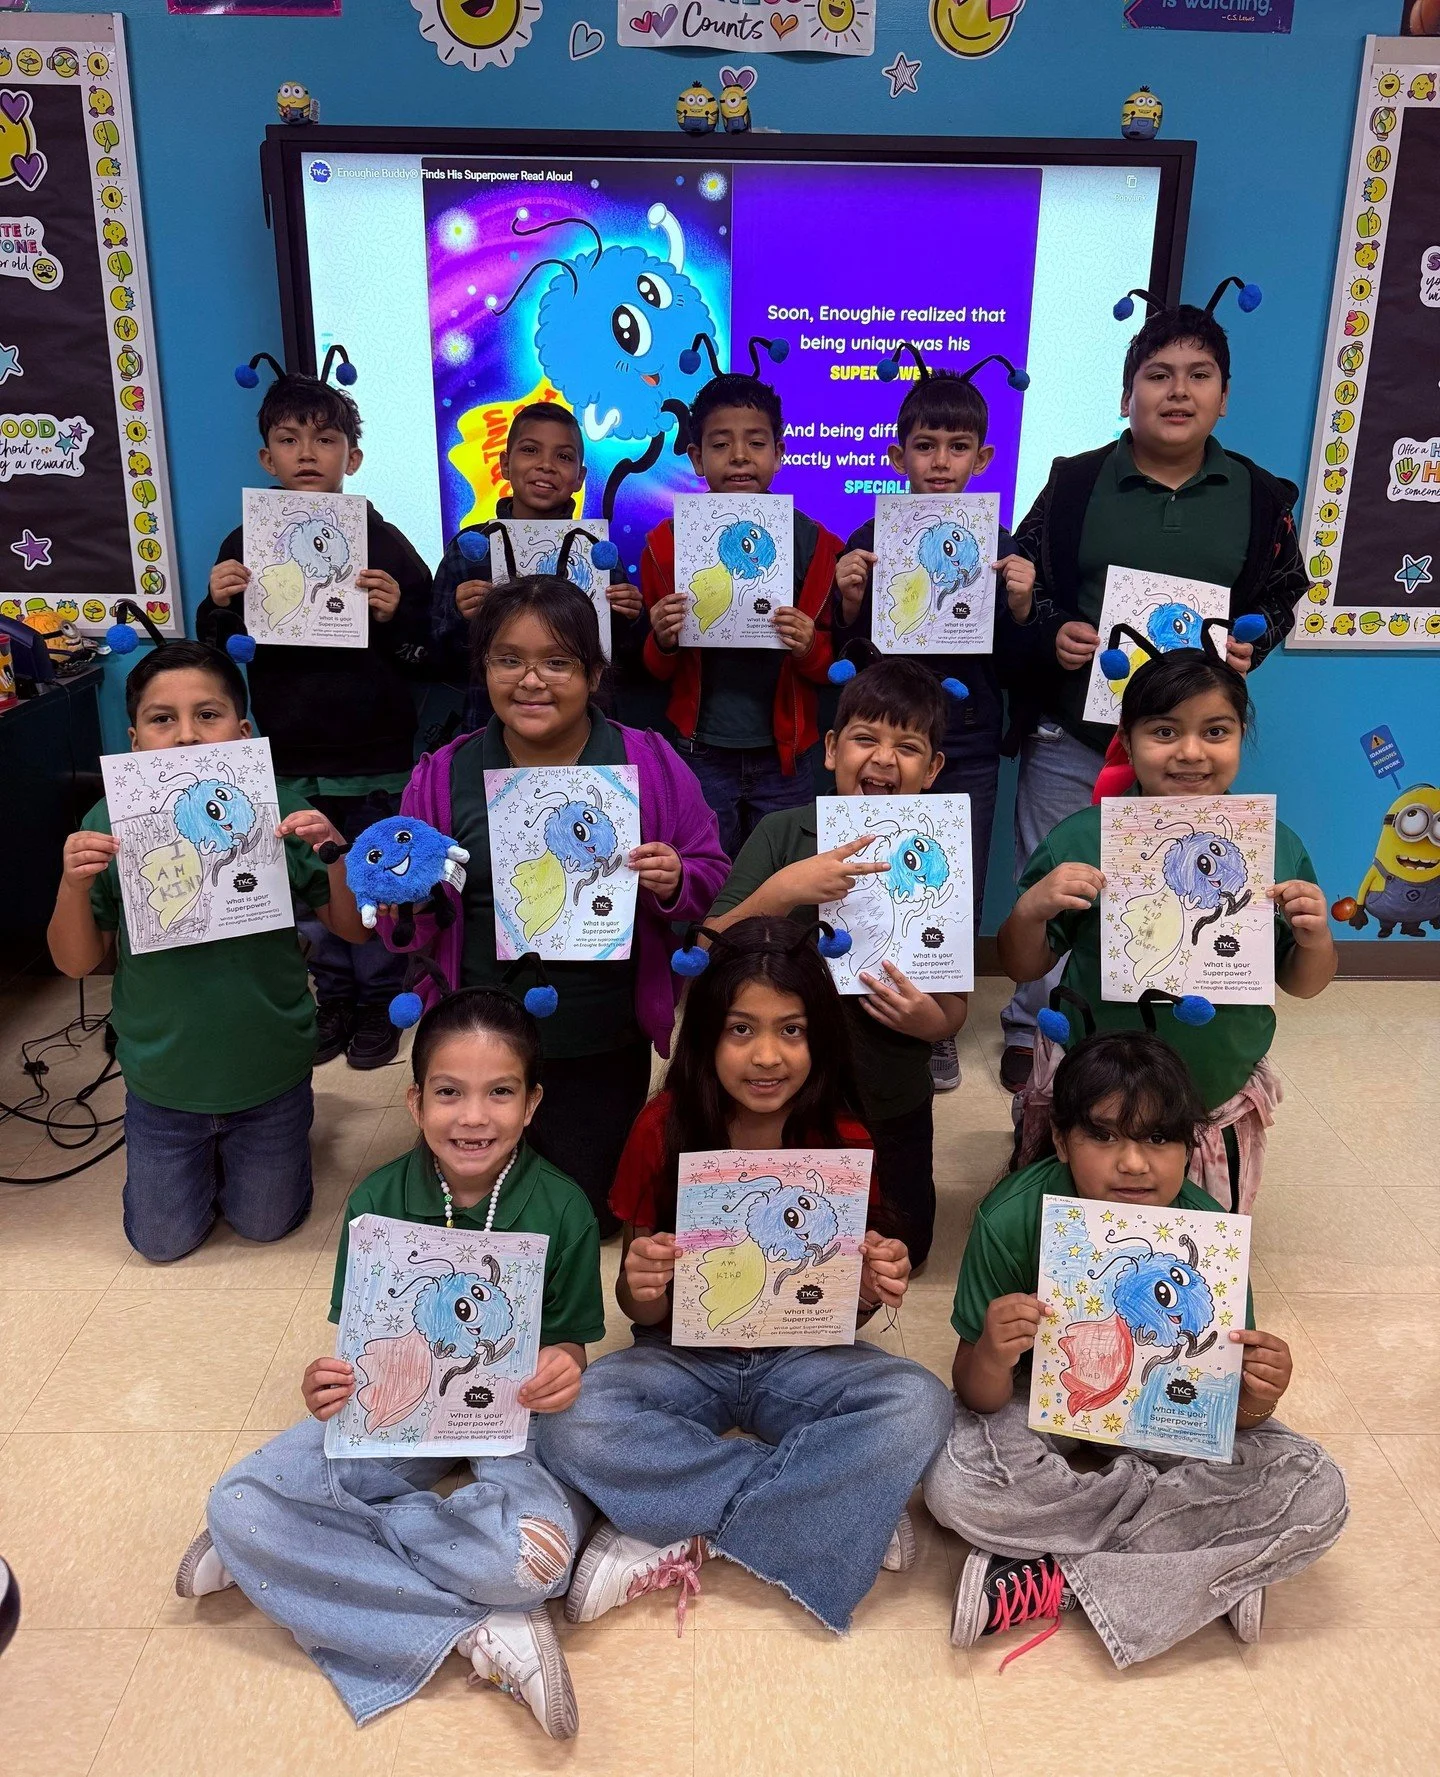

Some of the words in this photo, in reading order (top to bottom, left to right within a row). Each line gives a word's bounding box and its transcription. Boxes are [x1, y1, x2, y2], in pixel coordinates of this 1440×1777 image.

[682, 1, 765, 41] Counts
[312, 168, 328, 177] TKC
[337, 167, 380, 179] Enoughie
[420, 168, 446, 180] Finds
[447, 169, 463, 180] His
[464, 170, 519, 182] Superpower
[520, 171, 544, 181] Read
[545, 171, 573, 182] Aloud
[767, 305, 814, 323] Soon,
[819, 305, 896, 325] Enoughie
[900, 306, 966, 322] realized
[970, 307, 1006, 323] that
[800, 334, 846, 353] being
[851, 336, 905, 353] unique
[910, 338, 943, 351] was
[948, 335, 971, 351] his
[0, 419, 56, 439] OOD
[783, 423, 816, 438] And
[819, 422, 865, 441] being
[869, 423, 899, 438] diff
[15, 460, 27, 470] a
[31, 451, 80, 471] reward.
[780, 451, 831, 469] xactly
[836, 452, 876, 467] what
[844, 480, 911, 494] SPECIAL!
[237, 878, 254, 886] TKC
[253, 894, 269, 902] your
[595, 901, 609, 909] TKC
[226, 900, 272, 913] Superpower?
[912, 960, 954, 968] Superpower?
[782, 1315, 833, 1323] Superpower?
[469, 1392, 489, 1400] TKC
[1172, 1386, 1191, 1396] TKC
[1152, 1405, 1176, 1414] What
[1187, 1411, 1207, 1419] your
[1150, 1414, 1208, 1428] Superpower?
